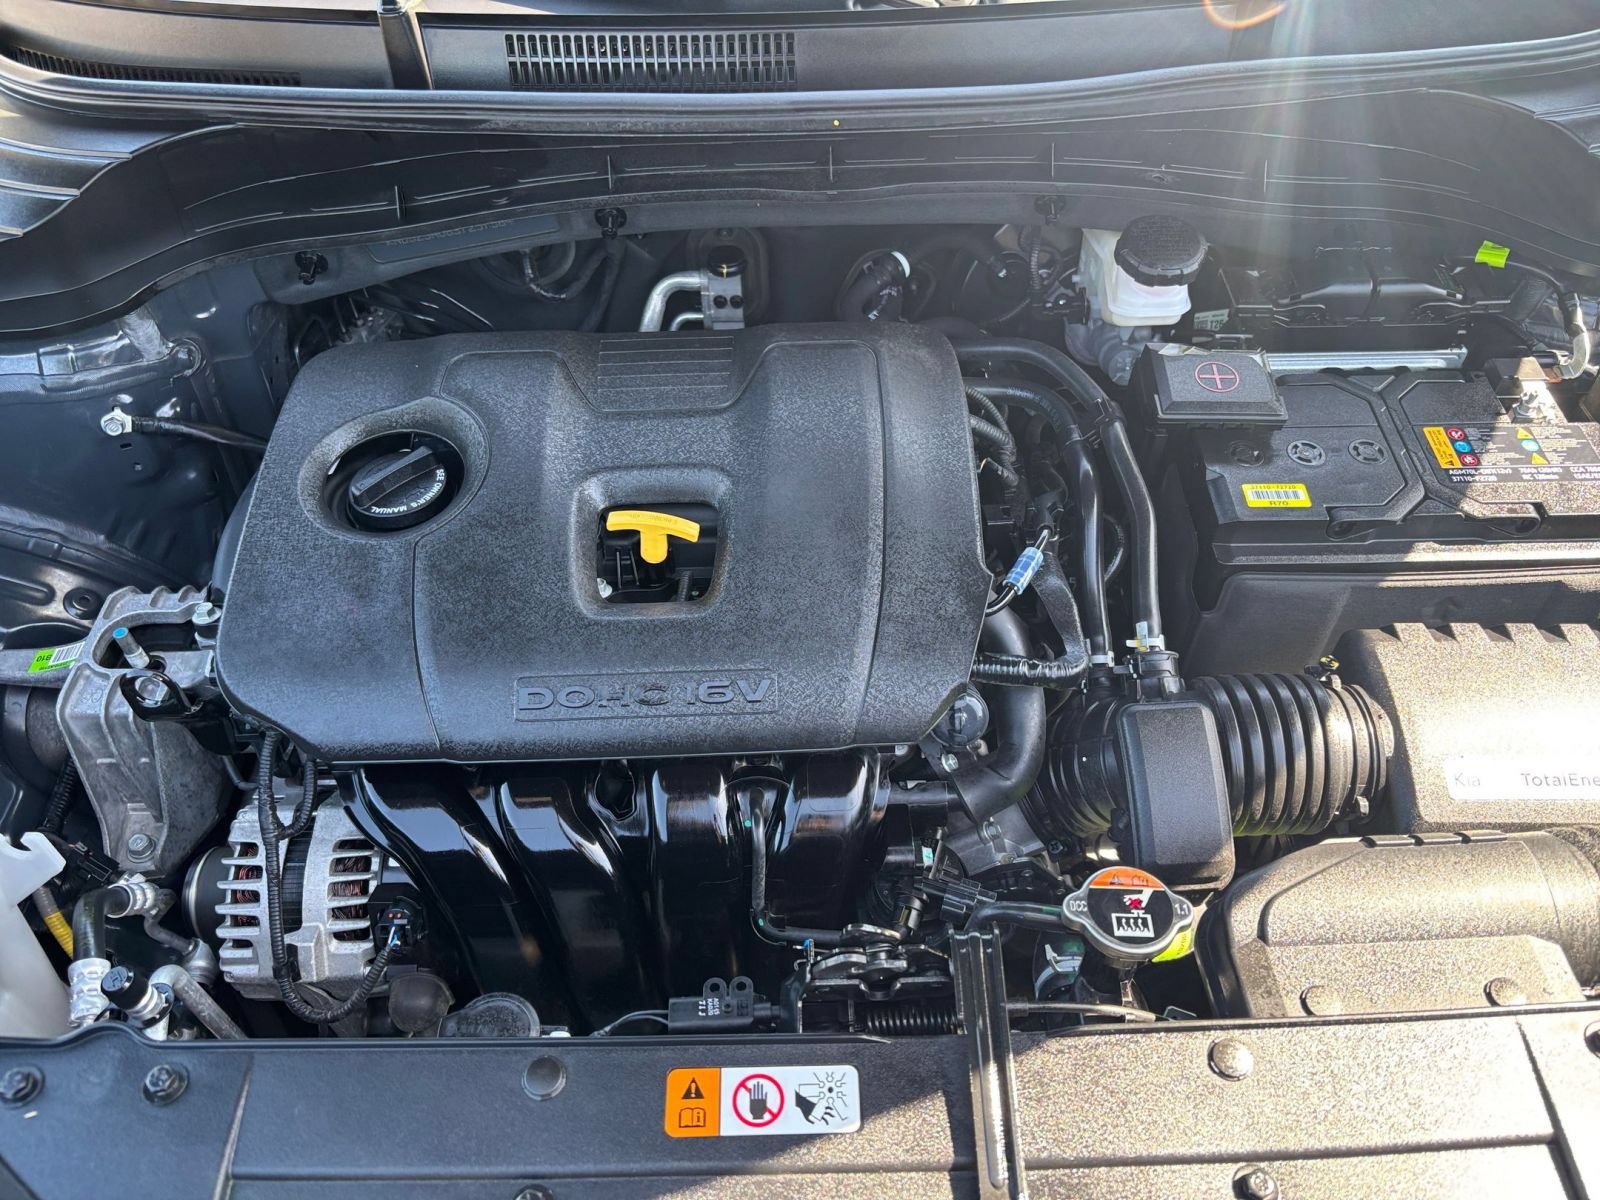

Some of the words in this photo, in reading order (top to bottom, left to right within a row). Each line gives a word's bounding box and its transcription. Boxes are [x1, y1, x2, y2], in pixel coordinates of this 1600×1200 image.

[435, 468, 445, 481] SEE
[410, 481, 442, 508] OWNER'S
[370, 505, 407, 514] MANUAL
[519, 686, 670, 710] DOHC
[686, 679, 770, 704] 16V
